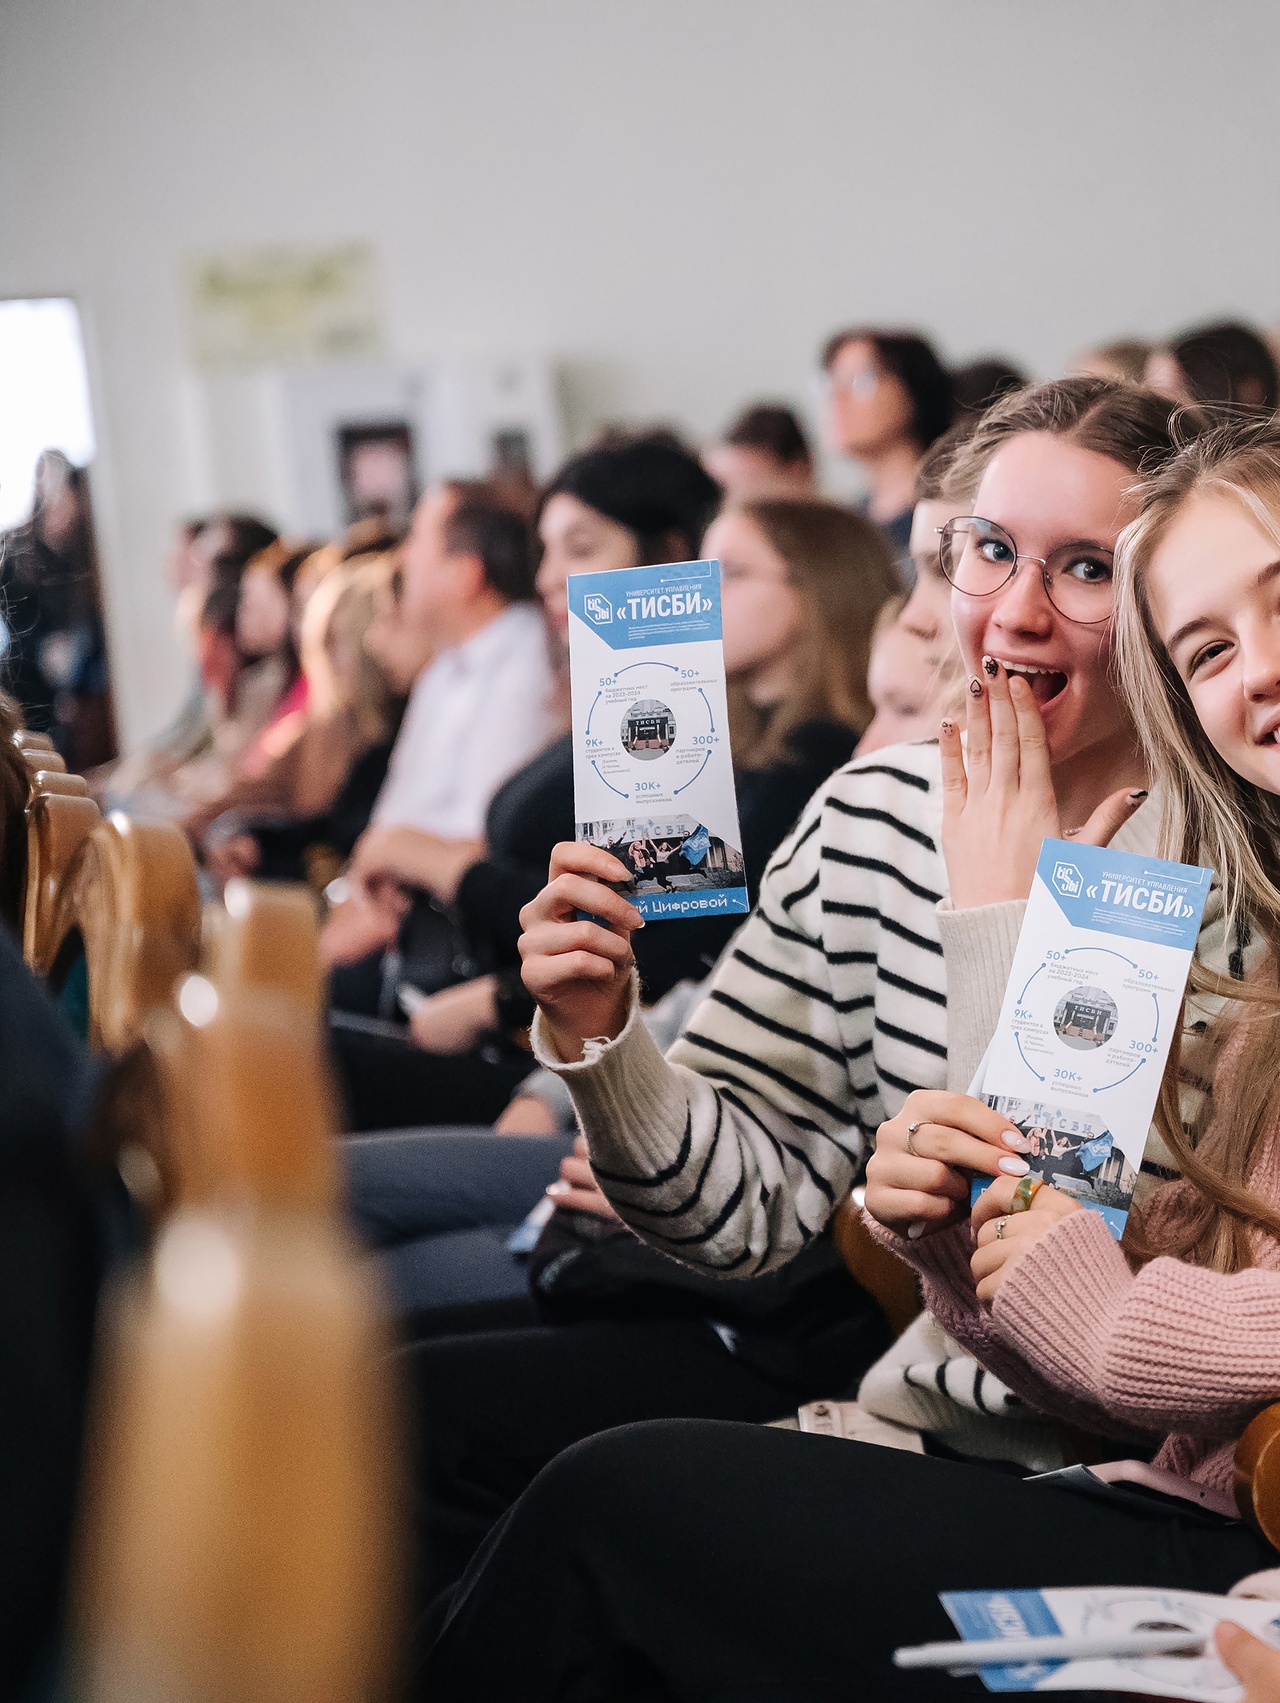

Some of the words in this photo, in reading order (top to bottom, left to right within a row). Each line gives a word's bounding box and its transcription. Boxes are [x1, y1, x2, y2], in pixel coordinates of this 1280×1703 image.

[626, 586, 664, 597] УНИВЕРСИТЕТ
[665, 584, 702, 594] УПРАВЛЕНИЯ
[616, 592, 713, 620] «ТИСБИ»
[681, 669, 700, 678] 50+
[600, 678, 617, 686] 50+
[692, 736, 720, 745] 300+
[1102, 871, 1145, 884] УНИВЕРСИТЕТ
[1147, 880, 1188, 894] УПРАВЛЕНИЯ
[652, 894, 728, 913] Цифровой
[1086, 880, 1194, 918] «ТИСБИ»
[1046, 950, 1066, 960] 50+
[1138, 969, 1160, 980] 50+
[1129, 1040, 1158, 1053] 300+
